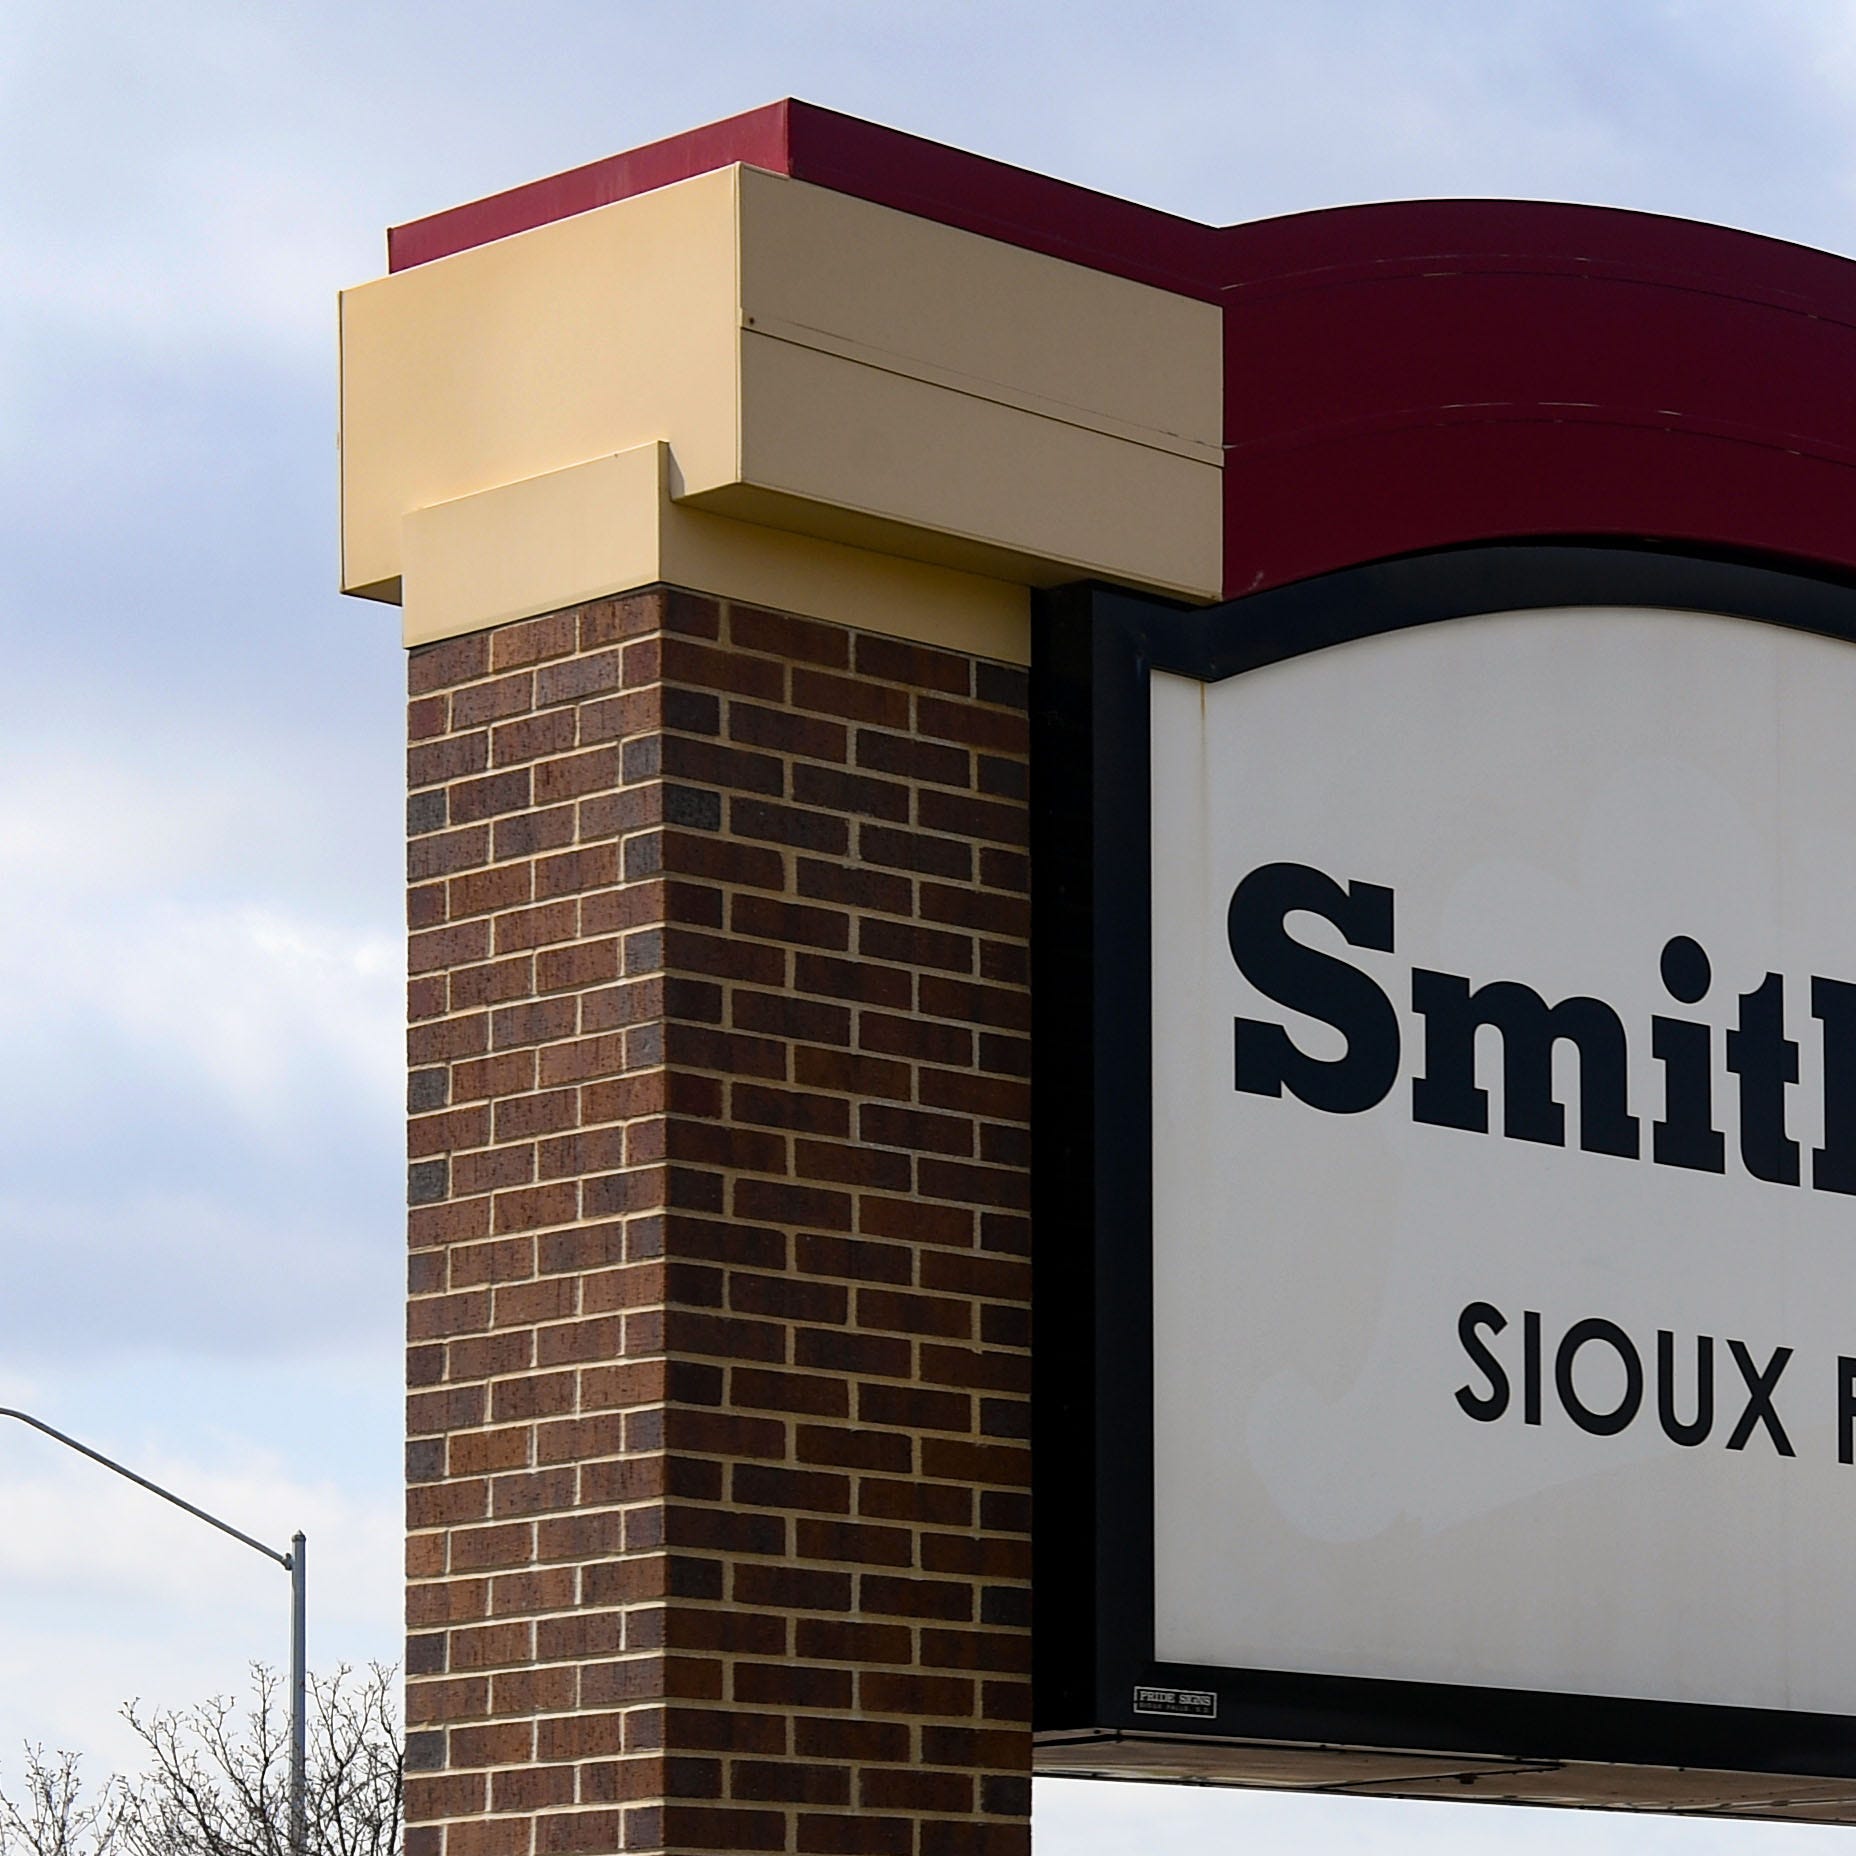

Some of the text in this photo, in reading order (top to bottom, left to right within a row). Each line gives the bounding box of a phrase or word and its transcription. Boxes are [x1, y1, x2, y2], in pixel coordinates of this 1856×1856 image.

[1454, 1301, 1797, 1458] SIOUX
[1139, 1691, 1211, 1706] PRIDE SIGNS
